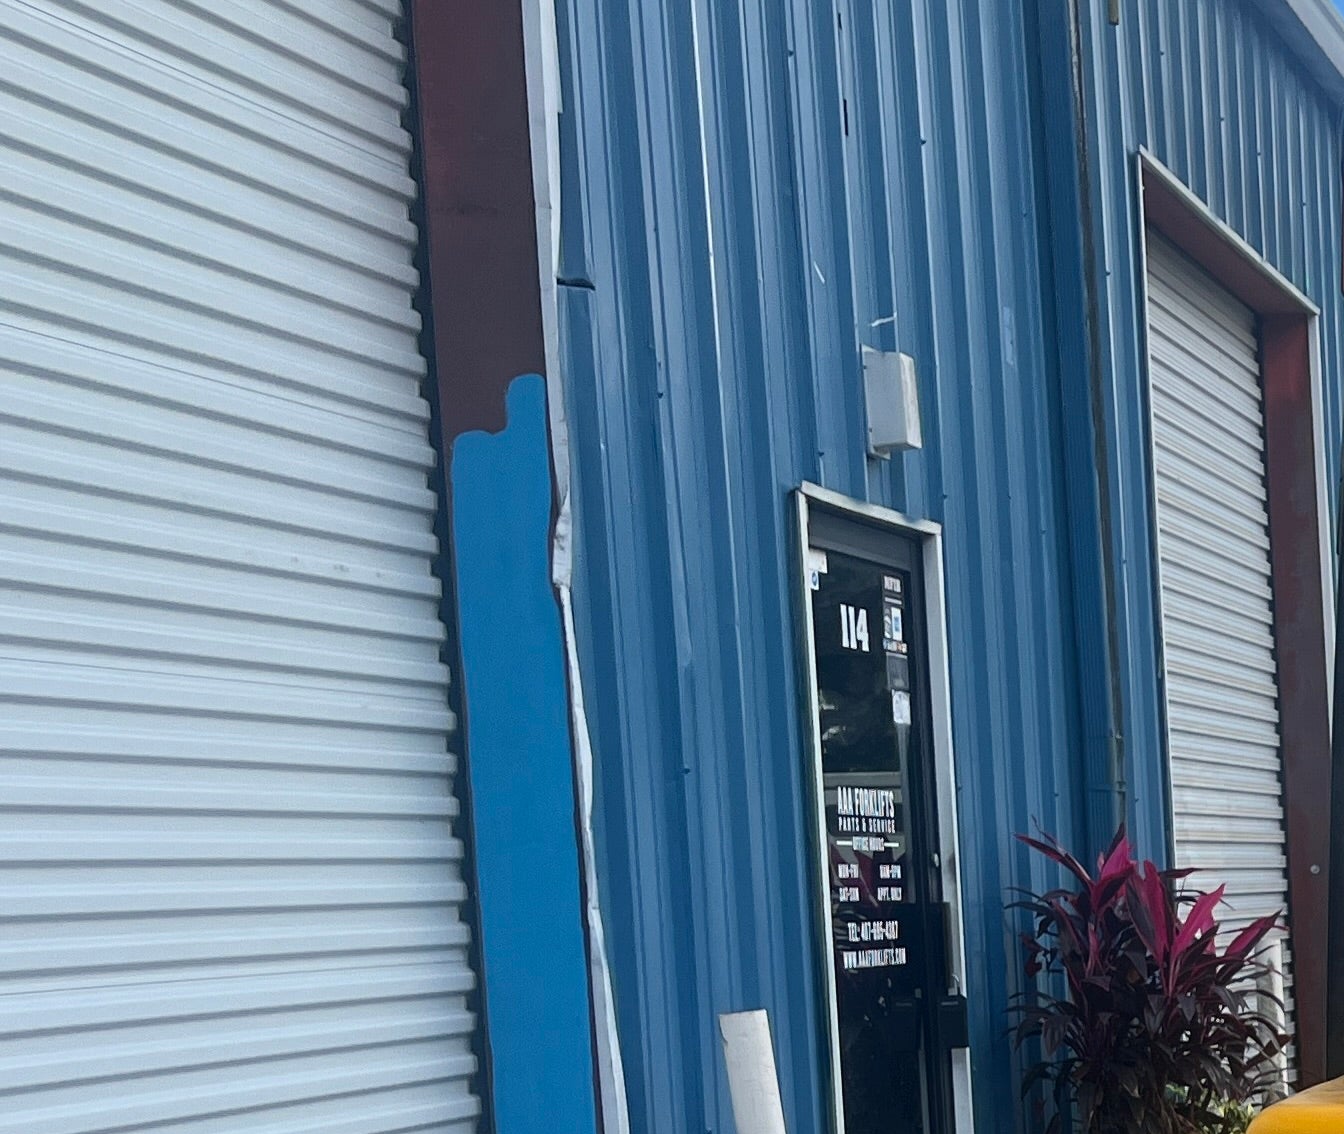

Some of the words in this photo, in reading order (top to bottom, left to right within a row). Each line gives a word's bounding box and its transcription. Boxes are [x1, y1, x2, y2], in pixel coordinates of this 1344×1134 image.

[840, 603, 870, 652] 114
[837, 786, 854, 816] AAA
[854, 787, 895, 818] FORKLIFTS
[838, 817, 860, 832] PARTS
[868, 818, 896, 834] SERVICE
